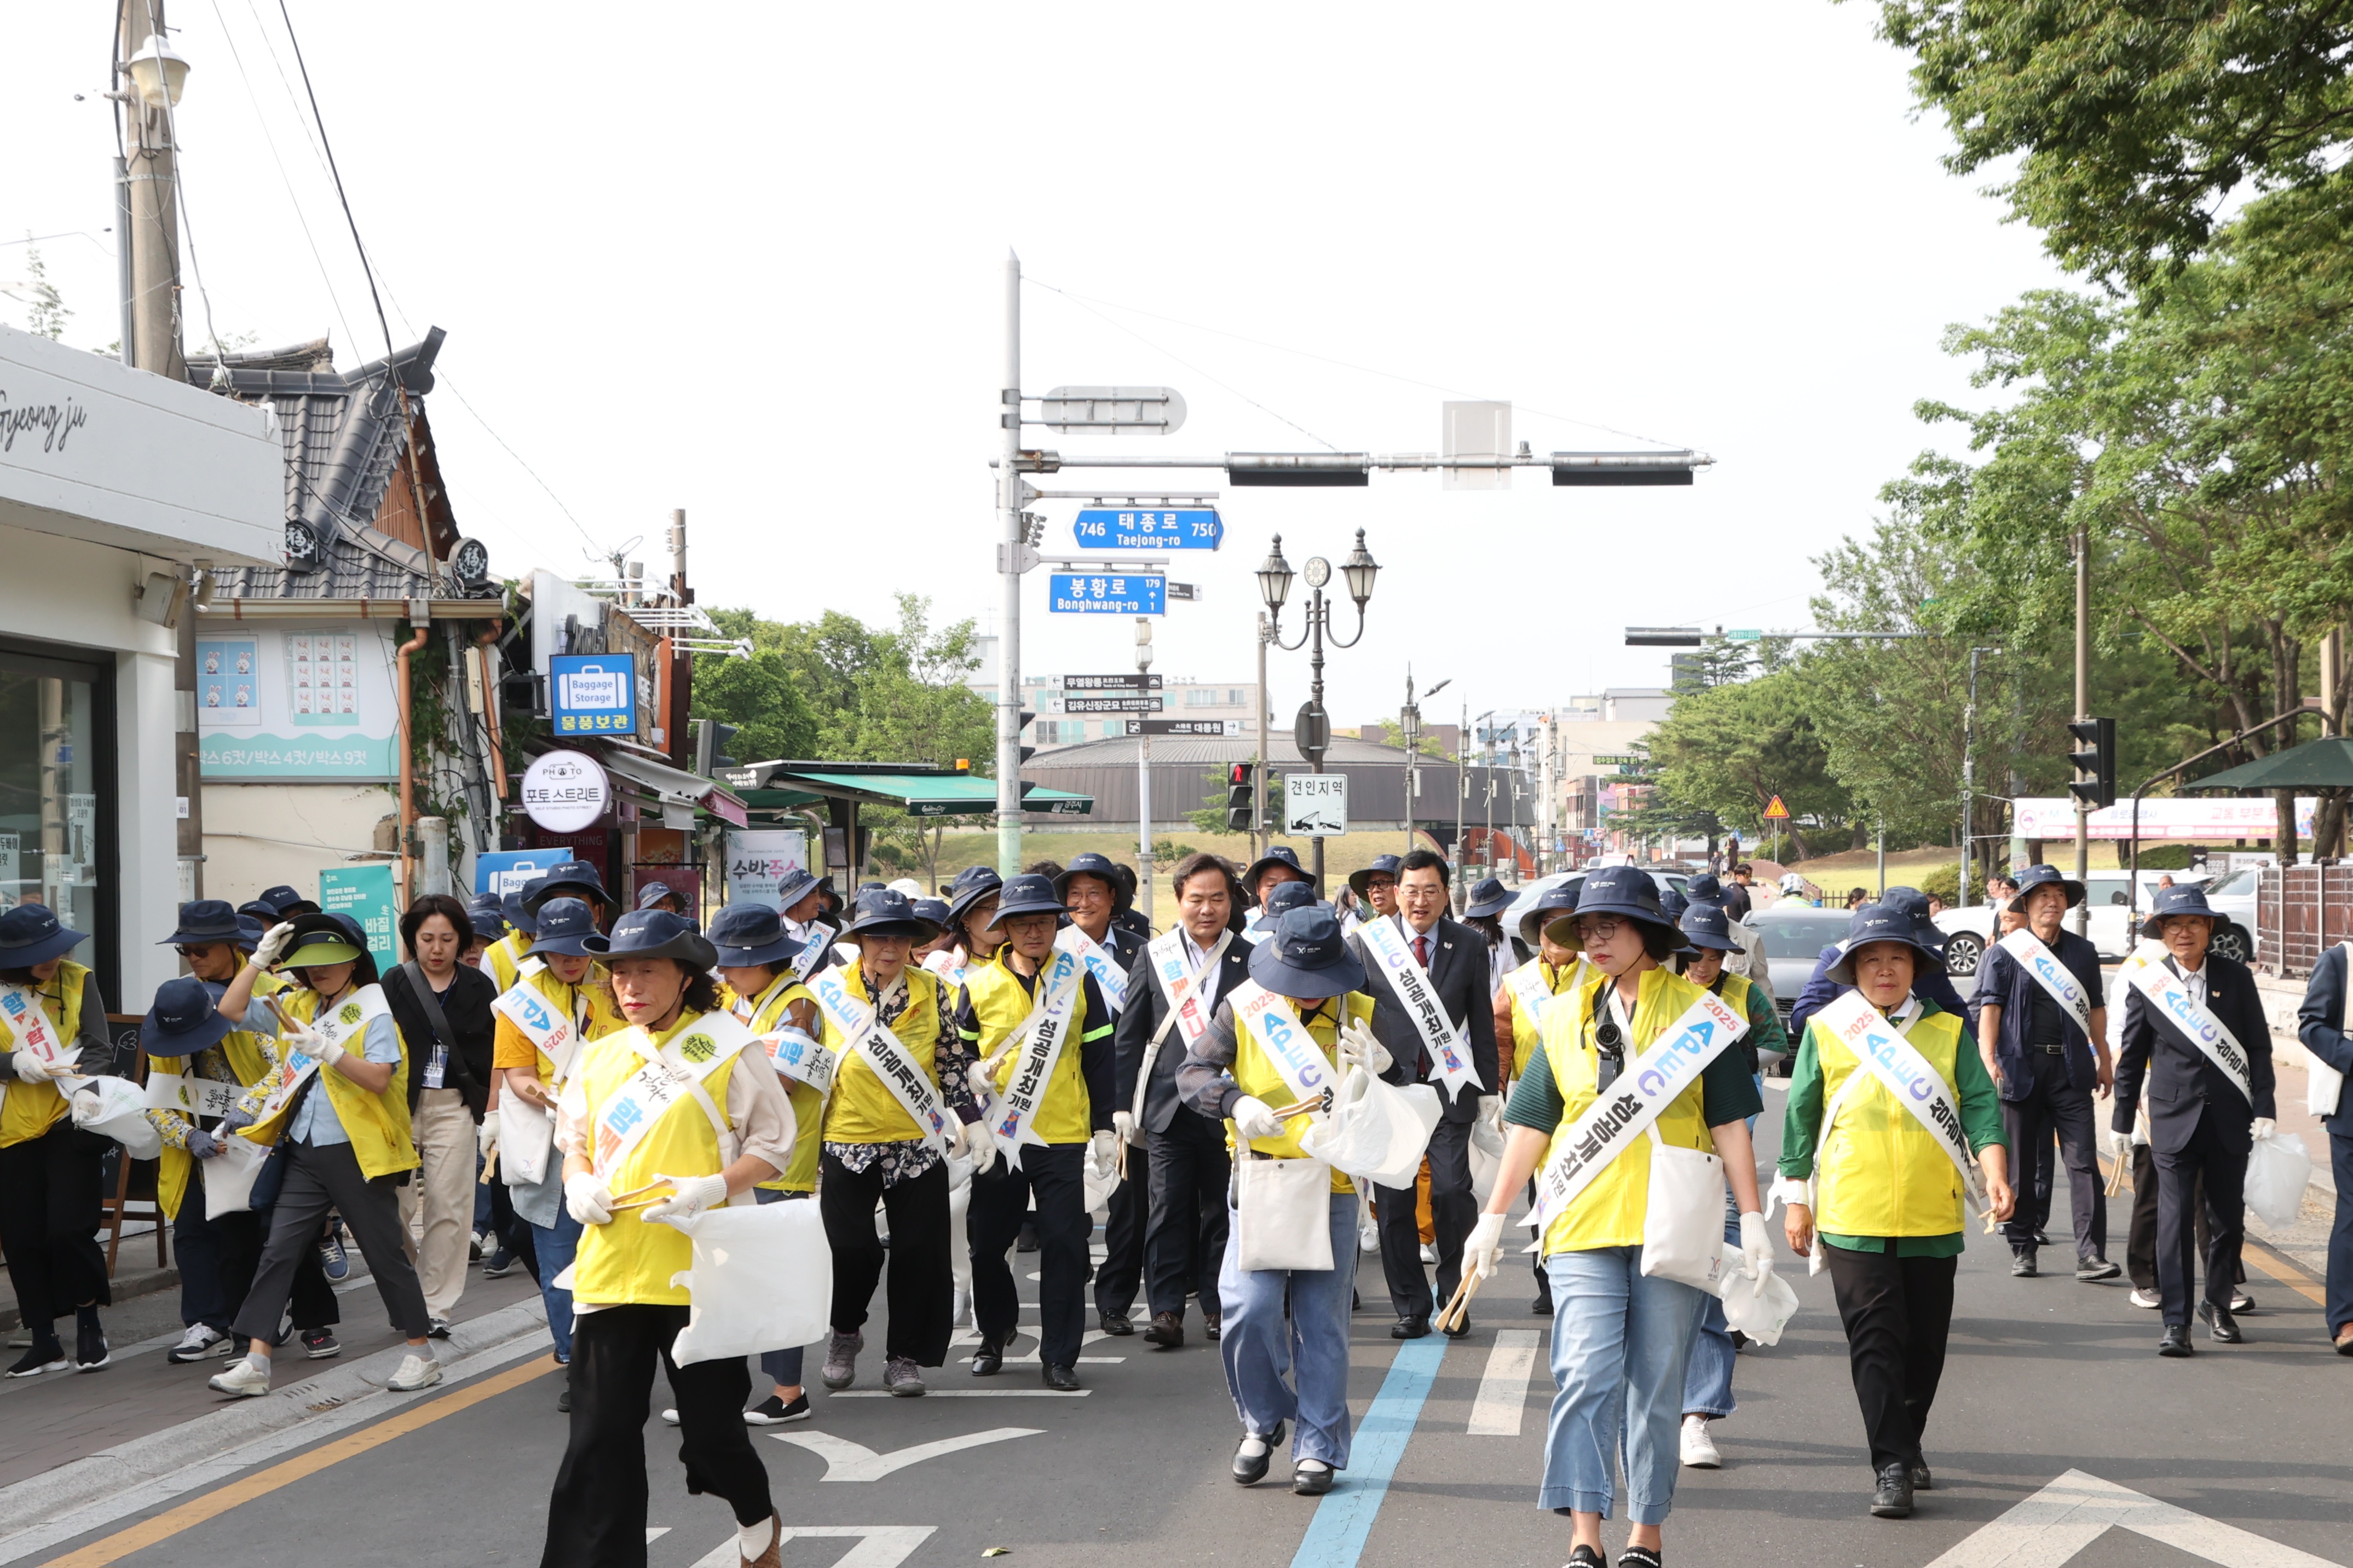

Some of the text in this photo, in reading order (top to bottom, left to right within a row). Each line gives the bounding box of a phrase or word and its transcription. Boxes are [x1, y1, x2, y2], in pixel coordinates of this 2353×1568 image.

[1080, 513, 1216, 536] 746 태종로 750
[1117, 534, 1181, 548] Taejong-ro
[464, 549, 480, 566] 福
[1070, 578, 1127, 599] 봉황로
[1145, 579, 1160, 588] 179
[1057, 598, 1155, 612] Bonghwang-ro 1
[573, 680, 613, 690] Baggage
[1066, 677, 1103, 688] 무열왕릉
[575, 693, 612, 703] Storage
[1068, 700, 1121, 711] 김유신장군묘
[561, 714, 628, 731] 물품보관
[1193, 722, 1221, 733] 대릉원
[222, 750, 281, 766] 6컷/박스
[284, 750, 343, 766] 4컷/박스
[344, 750, 367, 766] 9컷
[1291, 780, 1342, 796] 견인지역
[1064, 800, 1082, 809] 경주시
[540, 835, 603, 846] EVERYTHING
[365, 917, 390, 933] 바질
[814, 924, 831, 937] 2025
[367, 935, 391, 952] 걸리
[798, 933, 821, 968] APEC
[2020, 943, 2041, 963] 2025
[937, 956, 955, 976] 2025
[2035, 956, 2078, 1001] APEC
[2148, 974, 2172, 998] 2025
[504, 987, 551, 1032] APE
[1162, 959, 1206, 1039] 함께합니
[1243, 990, 1276, 1018] 2025
[1399, 968, 1444, 1035] 성공개최
[1702, 997, 1740, 1032] 2025
[2165, 990, 2217, 1043] APEC
[1843, 1010, 1875, 1042] 2025
[543, 1024, 568, 1052] 2025
[1431, 1031, 1452, 1050] 기원
[1016, 1019, 1058, 1097] 성공개최
[1264, 1012, 1322, 1088] APEC
[1637, 1020, 1715, 1097] APEC
[867, 1033, 925, 1104] 성공개최
[1866, 1033, 1933, 1101] APEC
[915, 1092, 934, 1116] 기원
[1008, 1093, 1034, 1112] 기원
[1559, 1092, 1645, 1182] 성공개최
[1548, 1166, 1567, 1199] 기원
